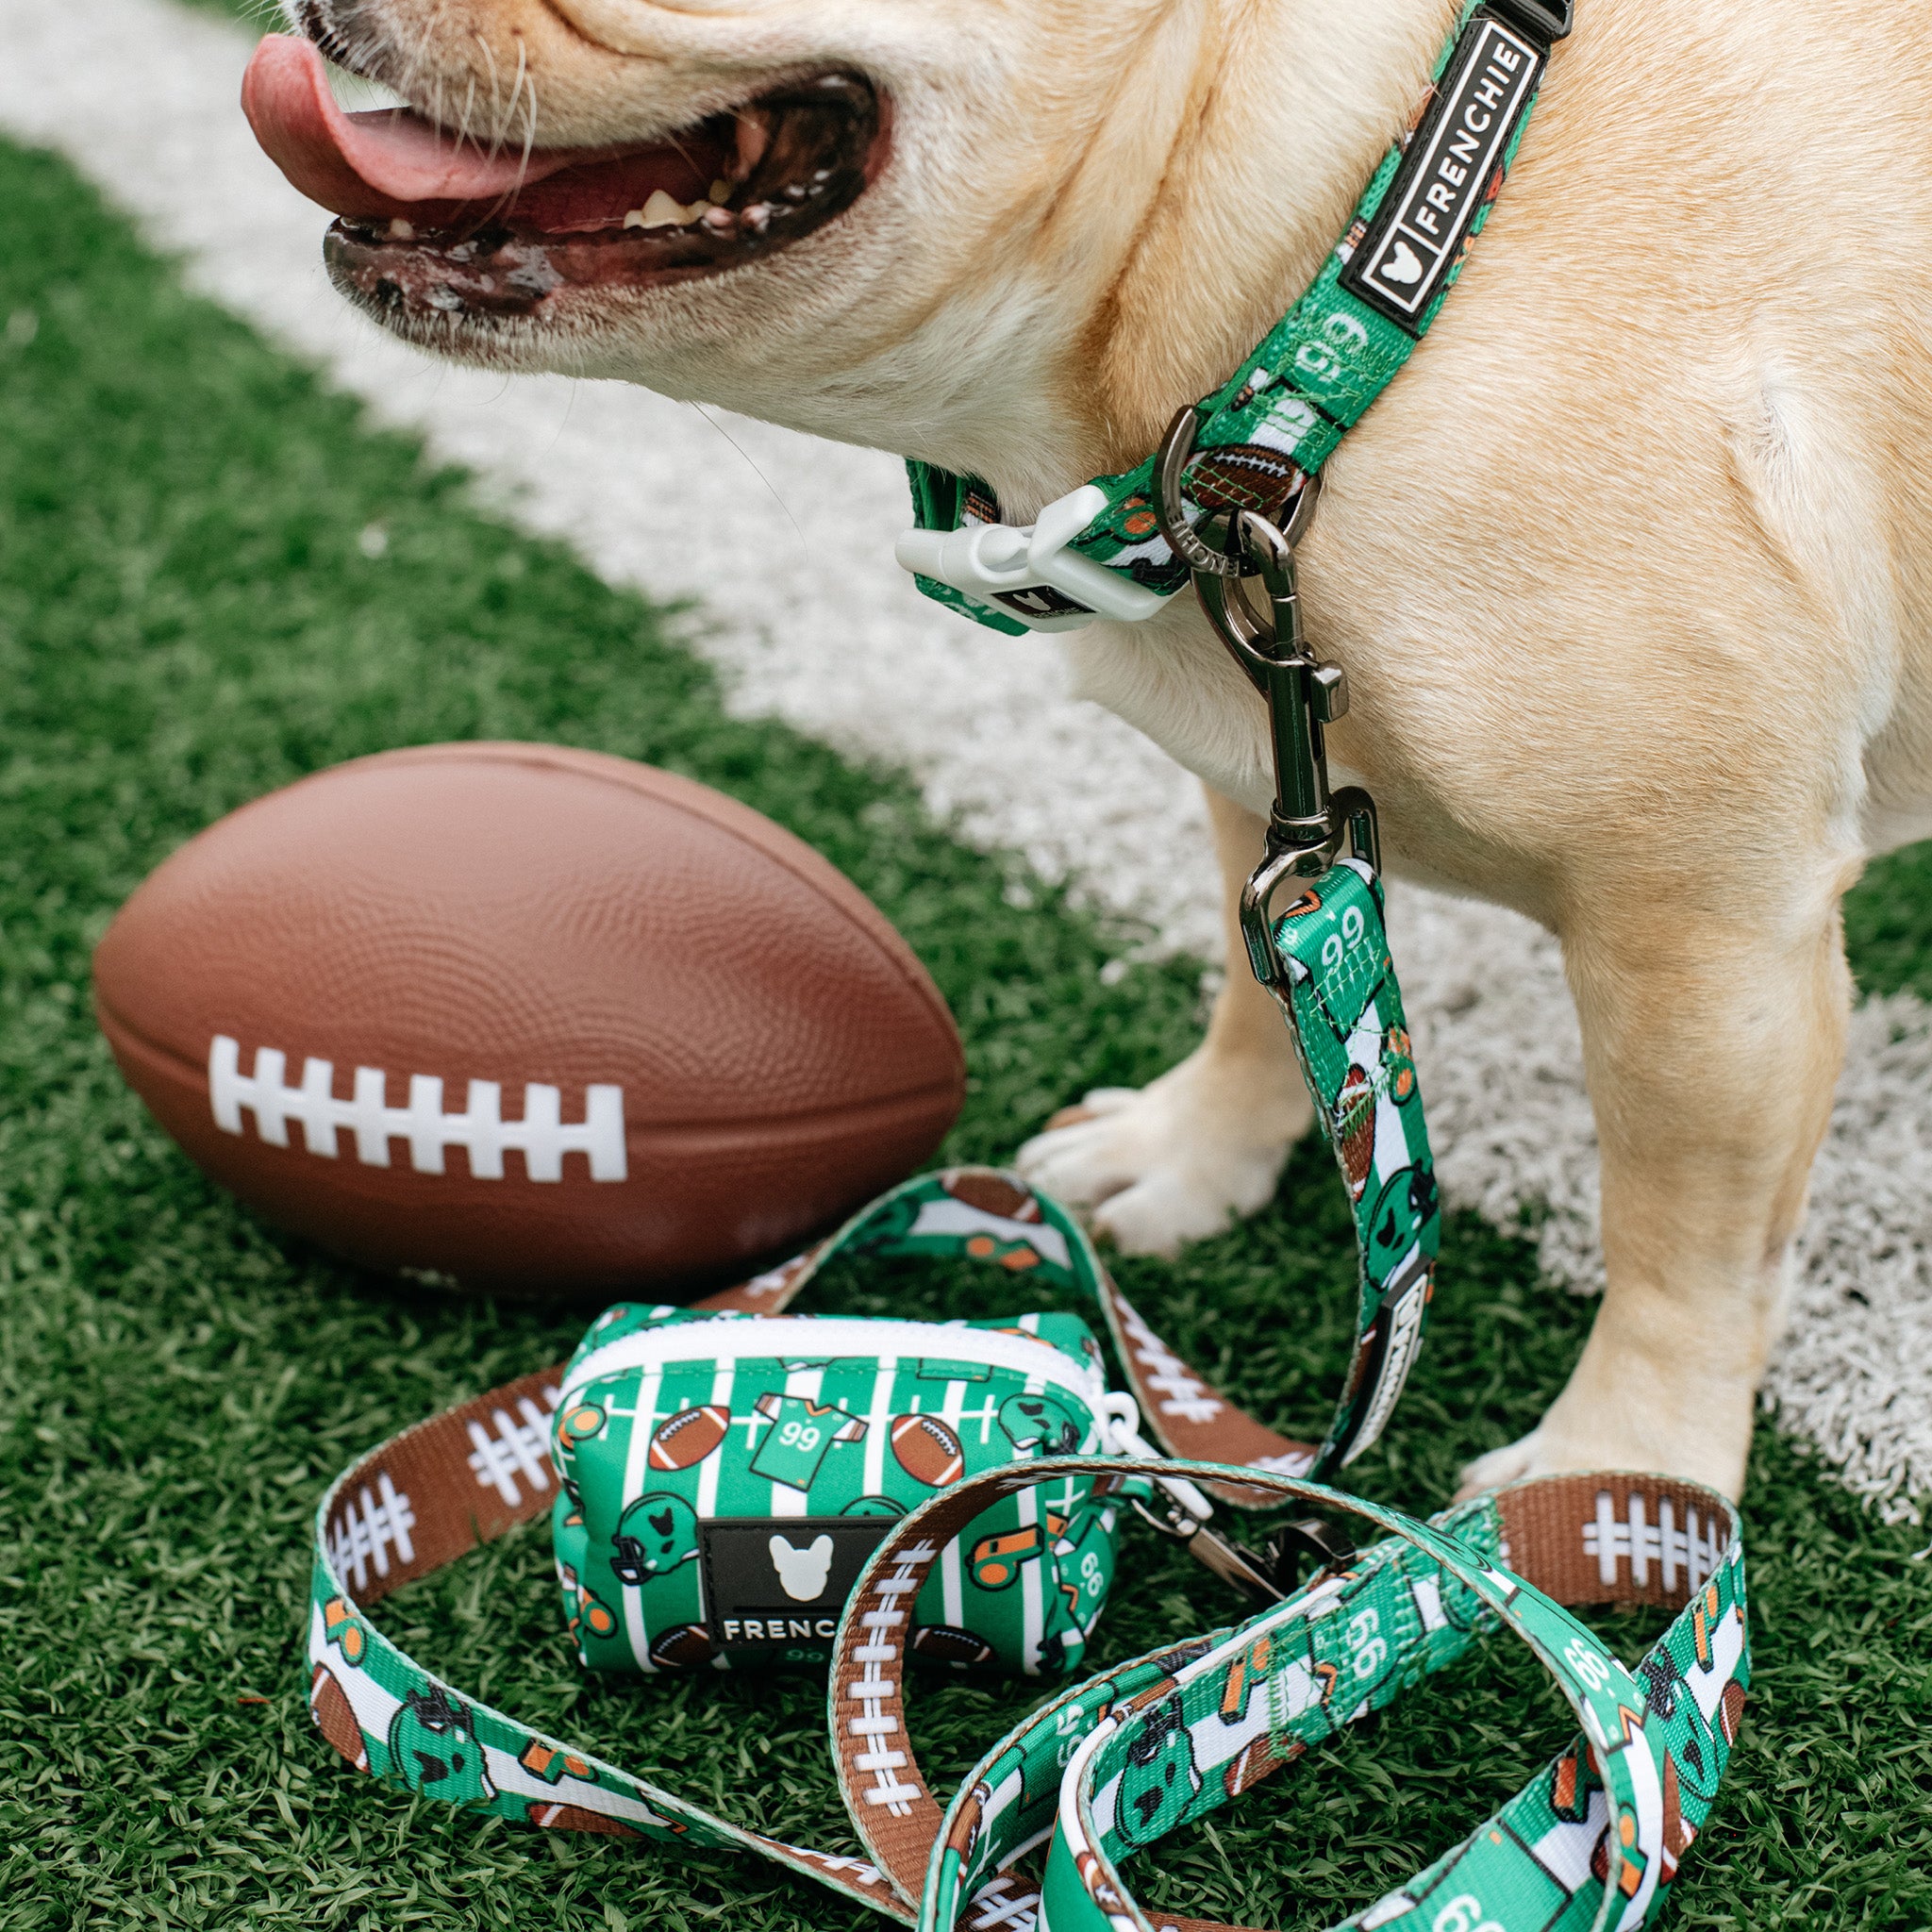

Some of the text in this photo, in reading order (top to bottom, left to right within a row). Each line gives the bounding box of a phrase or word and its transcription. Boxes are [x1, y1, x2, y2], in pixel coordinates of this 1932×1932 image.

[1415, 42, 1521, 235] FRENCHIE
[1322, 905, 1365, 966] 99
[778, 1422, 821, 1452] 99
[724, 1619, 836, 1641] FRENC
